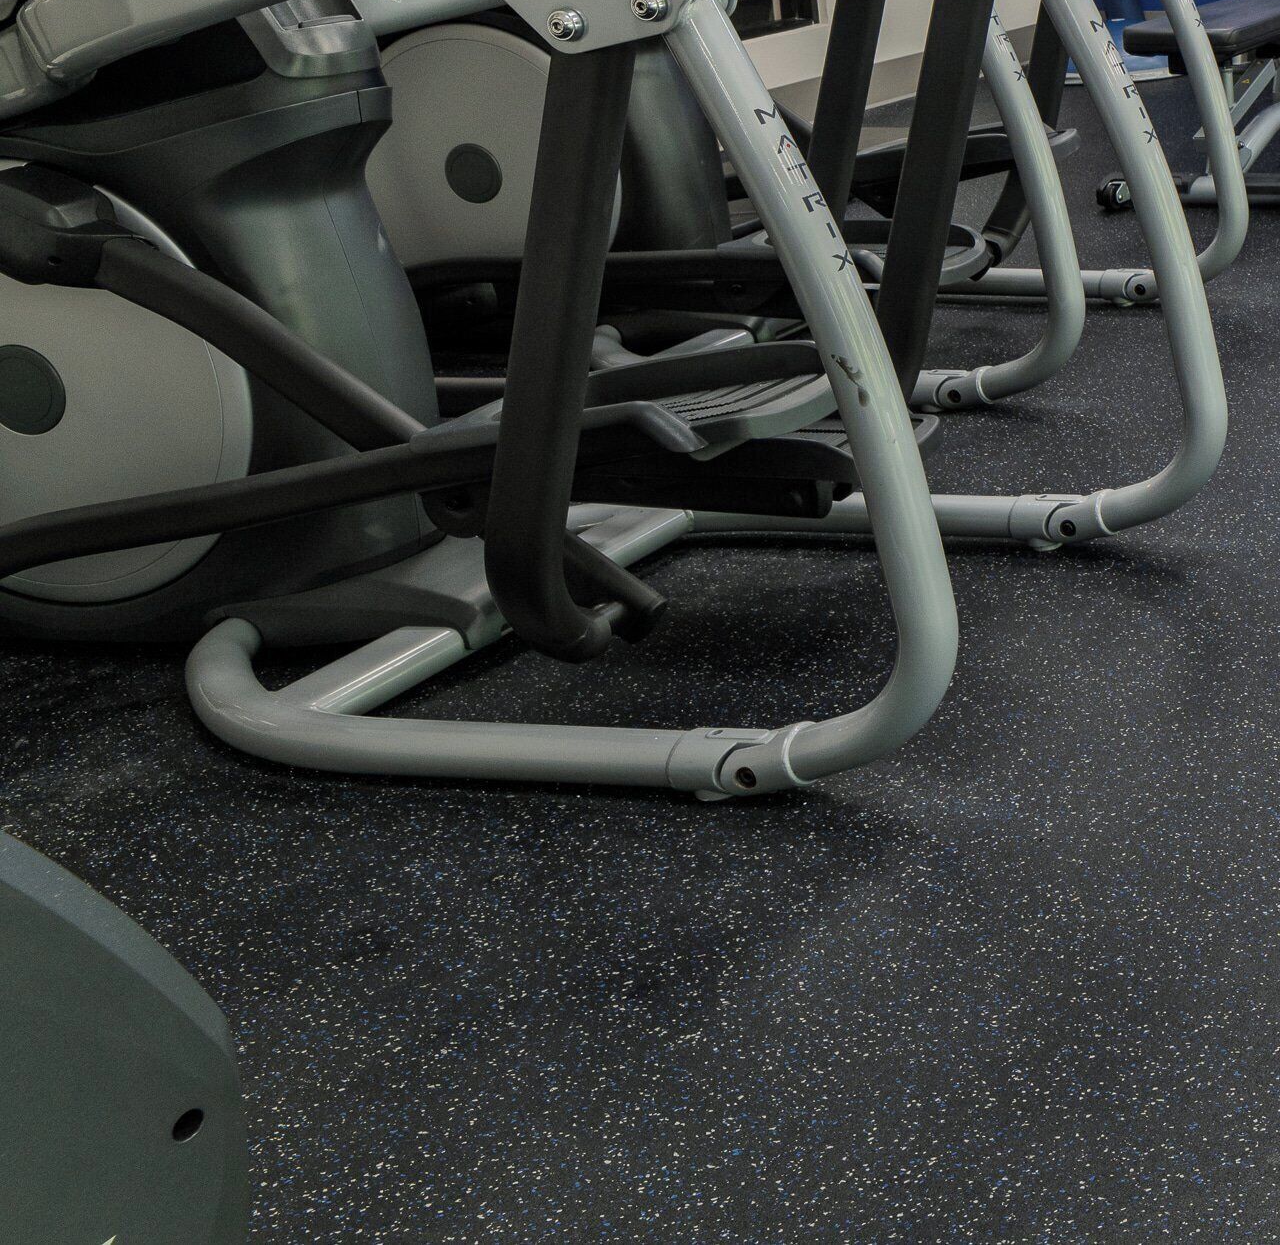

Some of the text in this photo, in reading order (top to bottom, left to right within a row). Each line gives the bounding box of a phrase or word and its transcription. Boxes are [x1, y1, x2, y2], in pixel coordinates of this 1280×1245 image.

[989, 14, 1027, 82] TRIX
[1089, 18, 1159, 144] MATRIX
[754, 103, 854, 272] MATRIX
